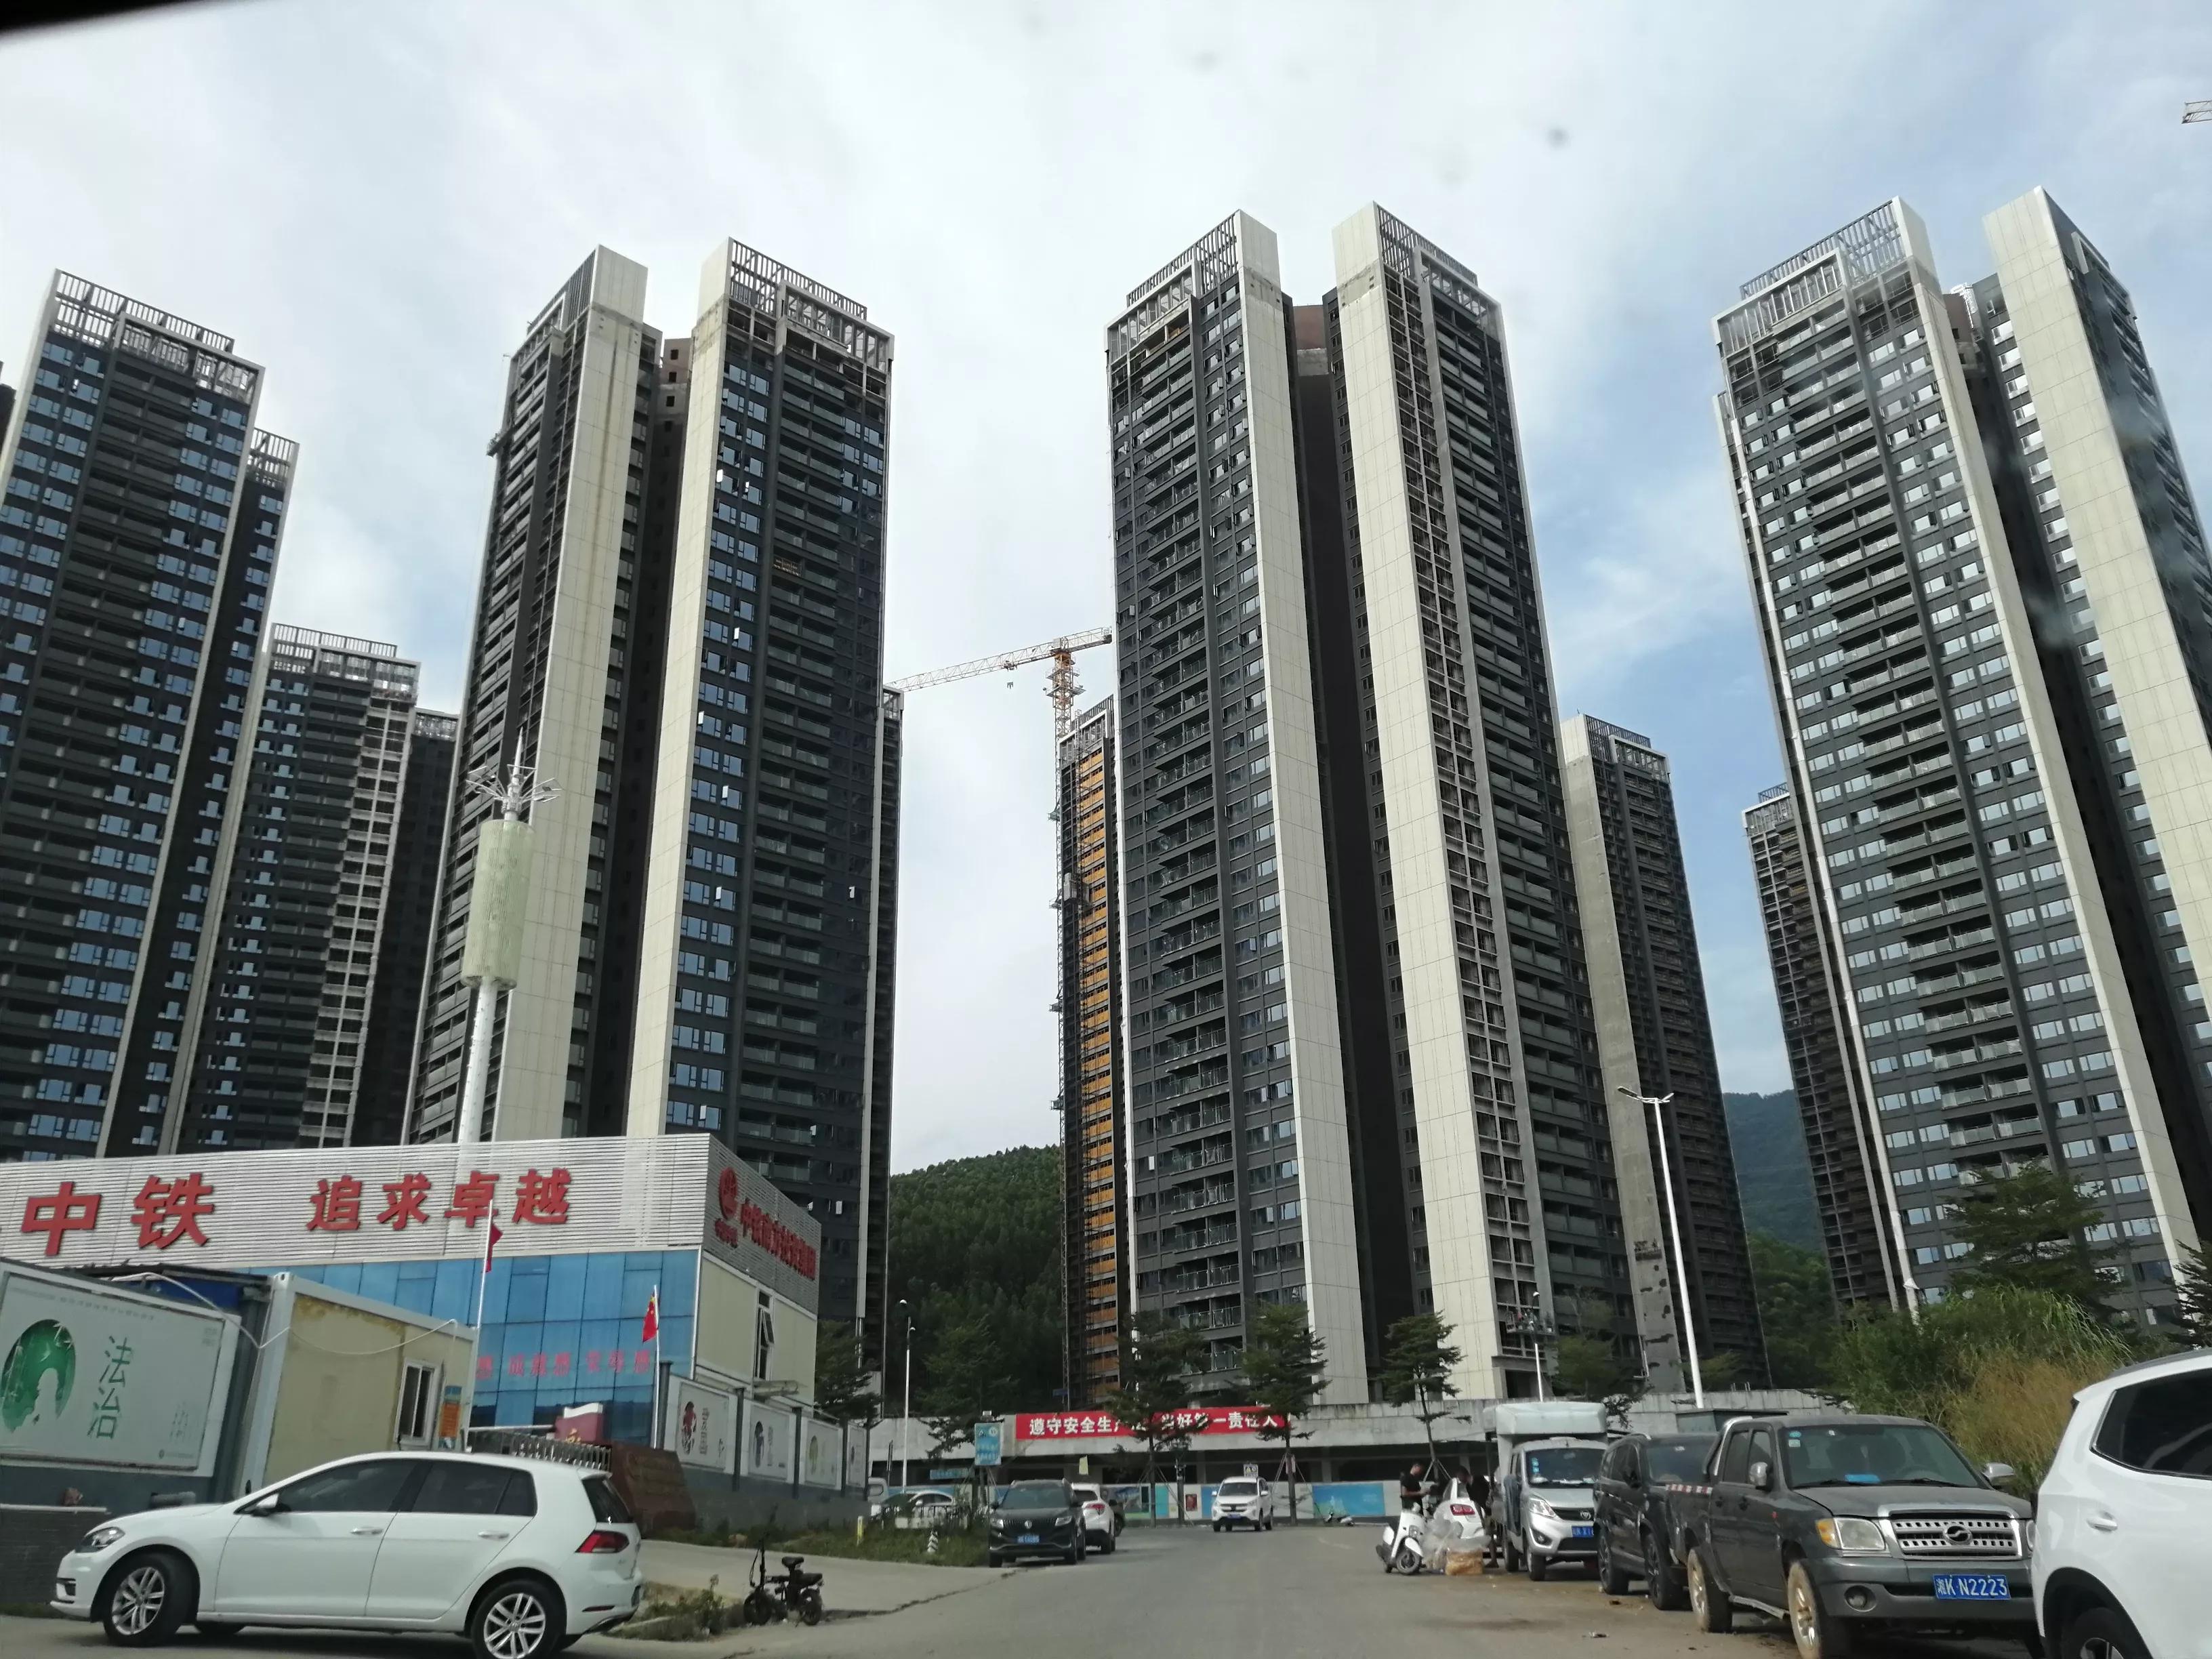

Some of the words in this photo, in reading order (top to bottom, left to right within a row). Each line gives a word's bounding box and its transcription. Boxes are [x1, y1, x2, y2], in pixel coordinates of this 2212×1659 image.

[21, 1172, 216, 1256] 中铁
[307, 1168, 571, 1231] 追求卓越
[87, 1335, 133, 1439] 法治
[1029, 1414, 1147, 1435] 遵守安全生
